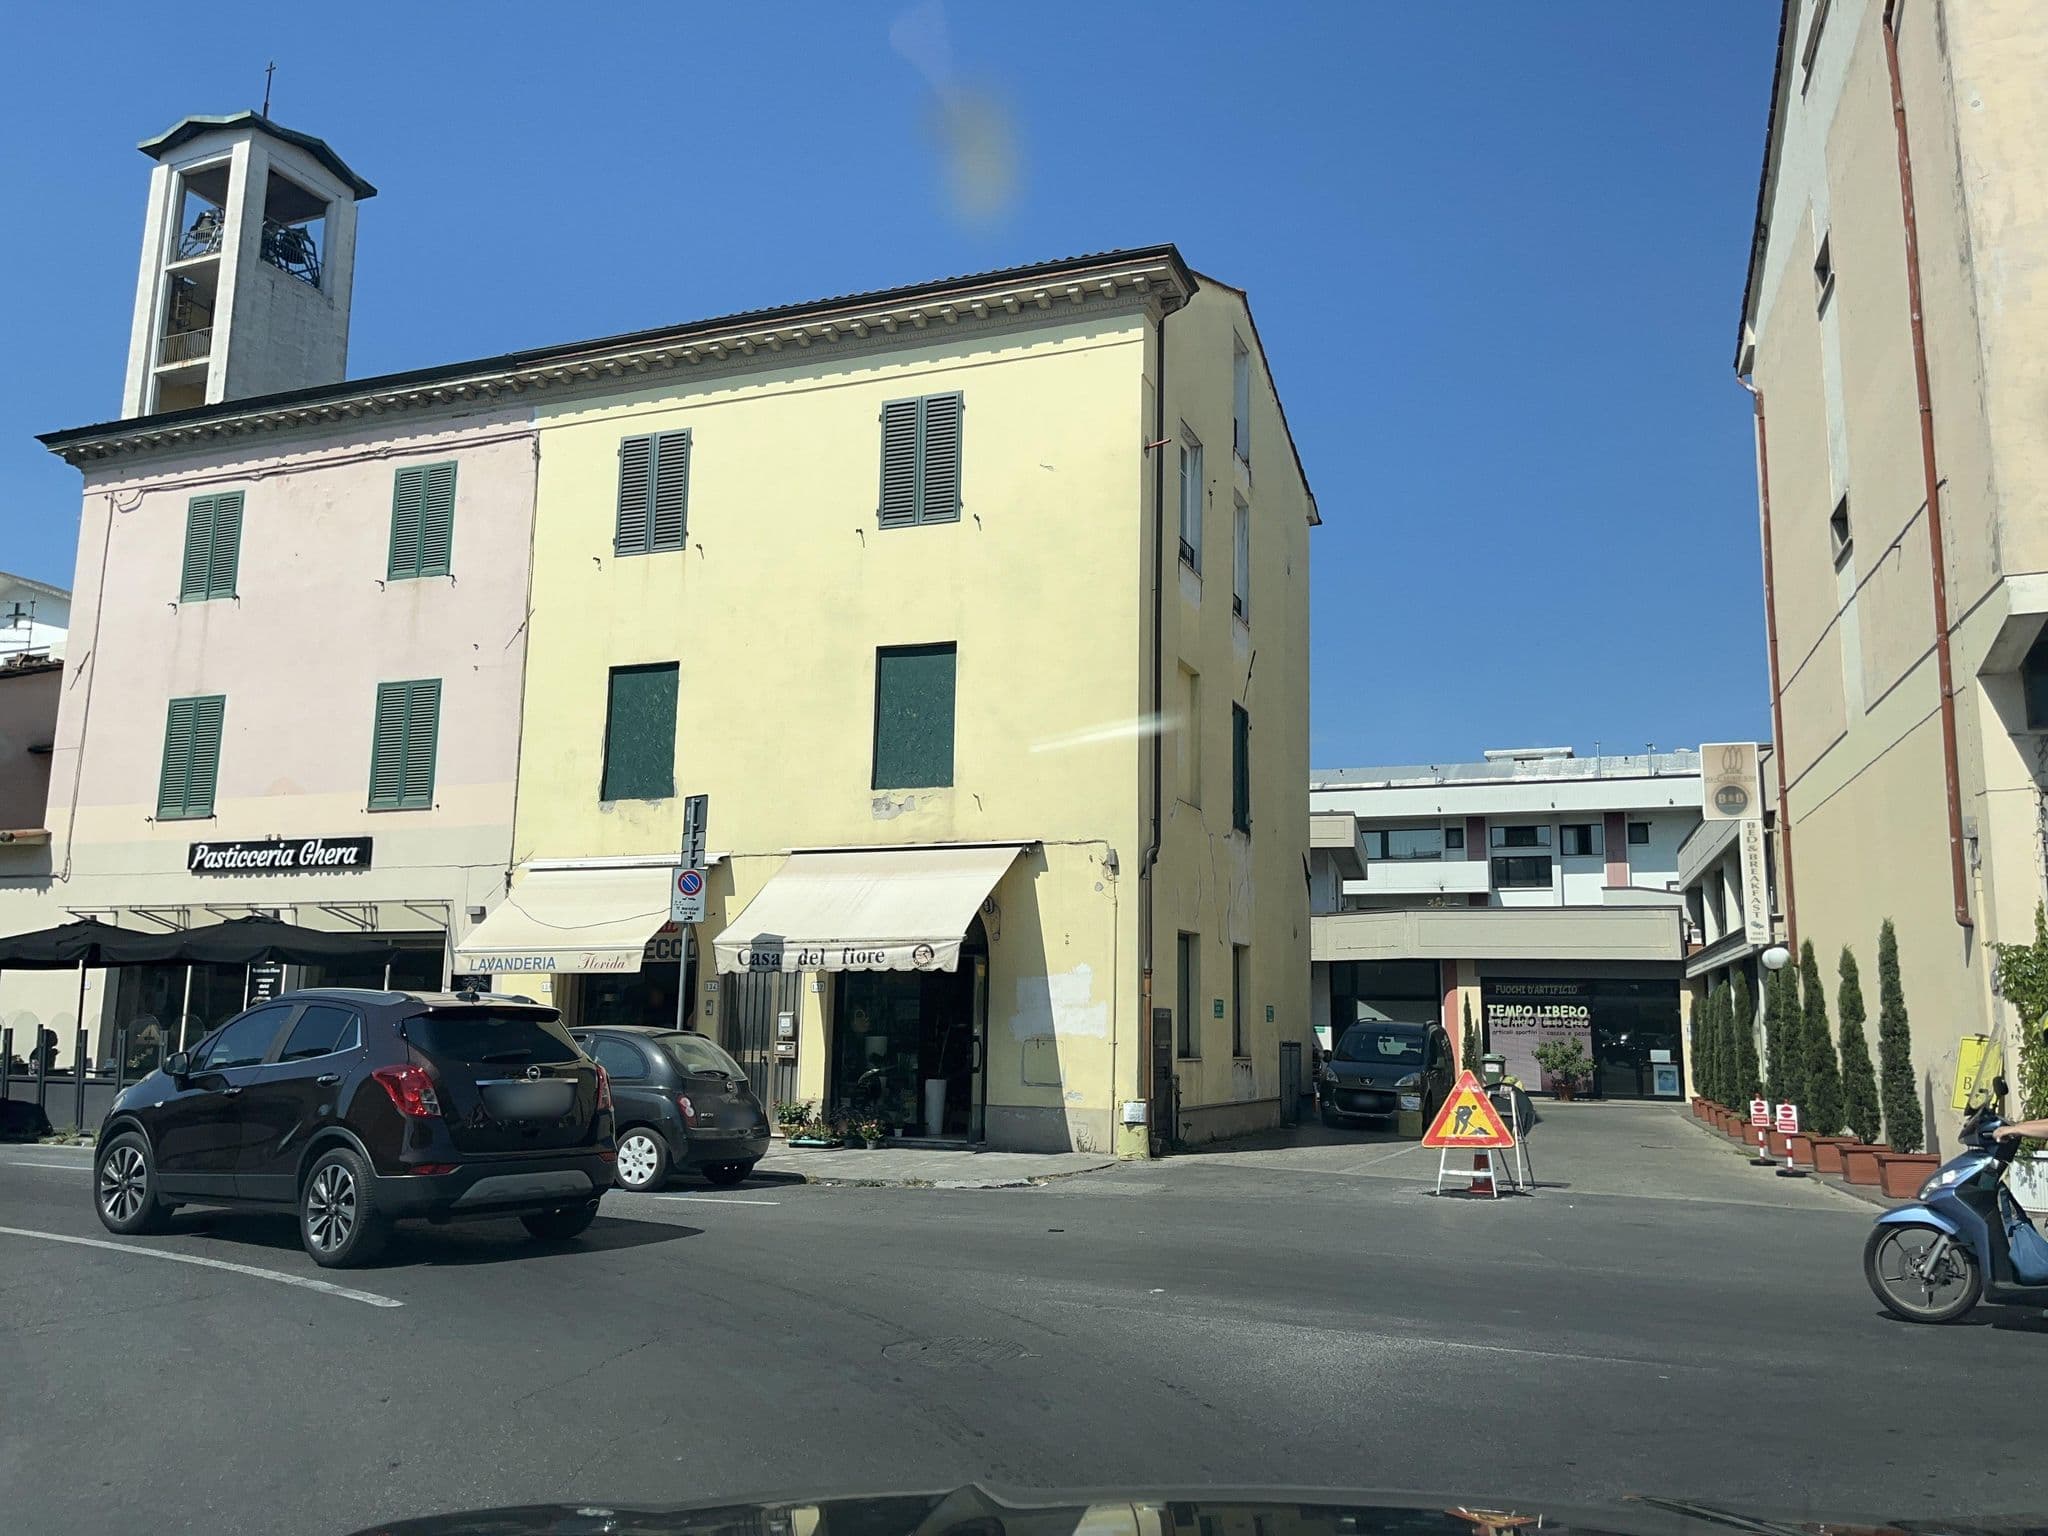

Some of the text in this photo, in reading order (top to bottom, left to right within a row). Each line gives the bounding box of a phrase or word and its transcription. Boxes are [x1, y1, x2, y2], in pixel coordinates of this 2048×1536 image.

[191, 838, 359, 869] Pasticceria Ghera
[470, 952, 626, 972] LAVANDERIA Florida
[737, 947, 886, 967] Casa del fiore
[1495, 984, 1578, 995] FUOCHI D'ARTIFICIO
[1487, 1004, 1588, 1018] TEMPO LIBERO
